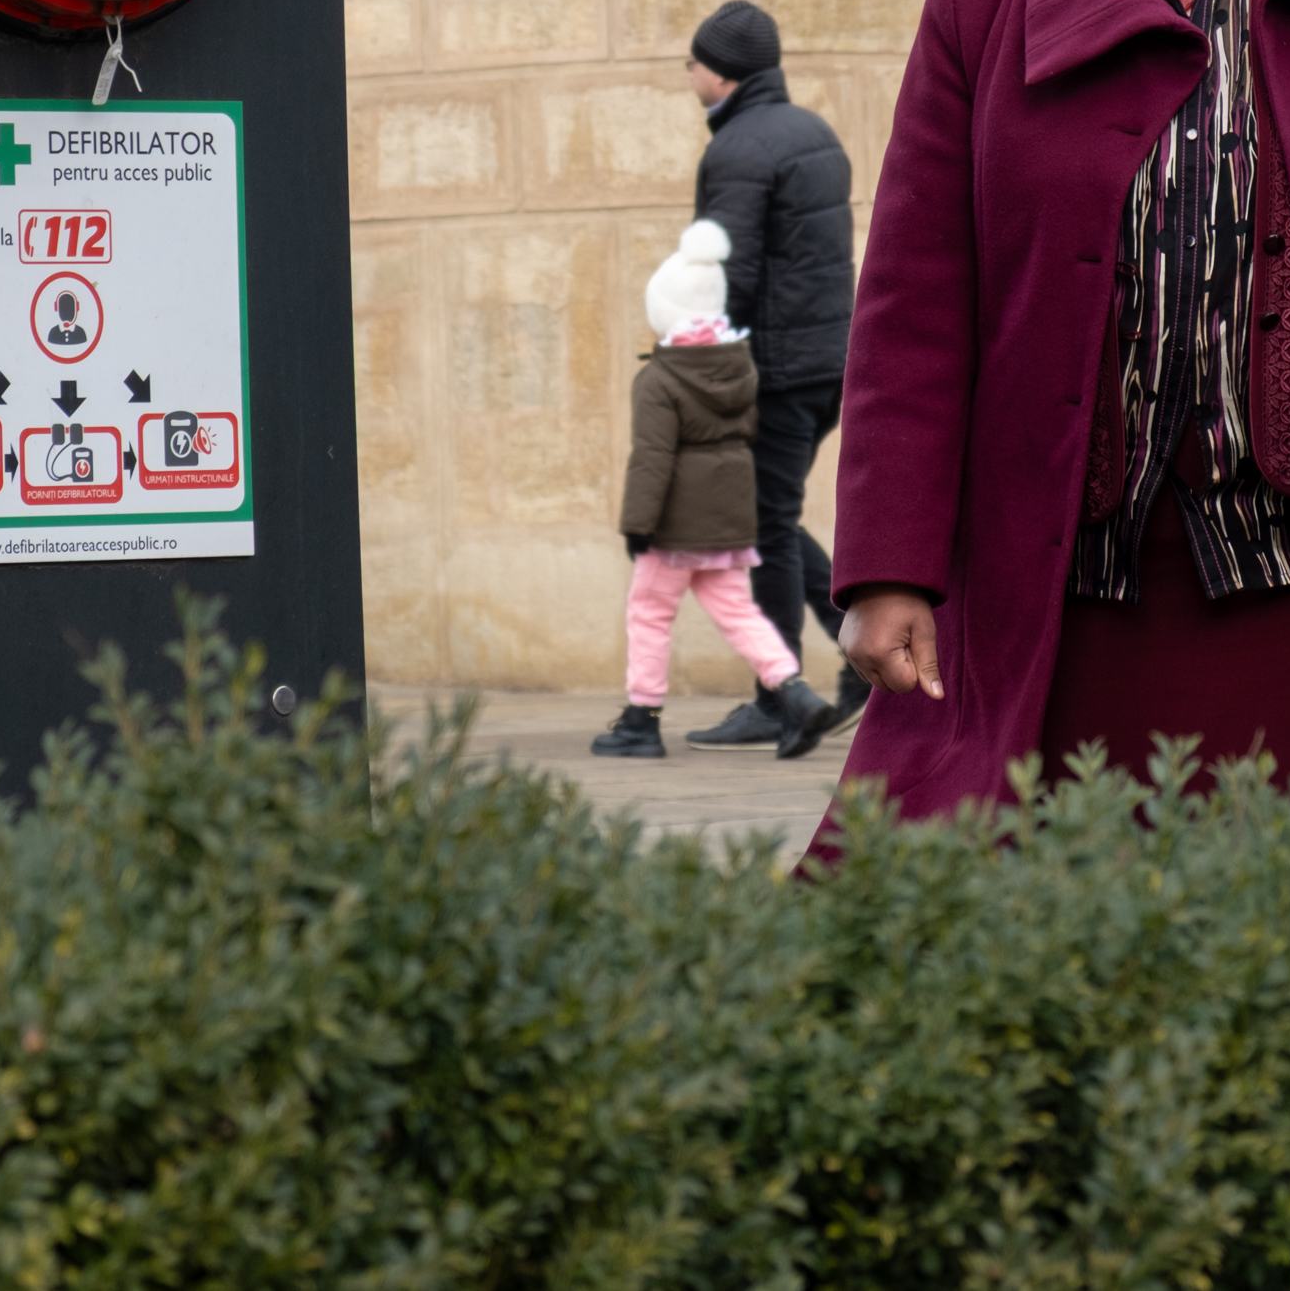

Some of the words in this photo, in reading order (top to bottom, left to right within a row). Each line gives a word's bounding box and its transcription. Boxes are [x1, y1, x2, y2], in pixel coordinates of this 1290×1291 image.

[47, 130, 217, 156] DEFIBRILATOR
[53, 167, 109, 186] pentru
[114, 166, 159, 182] acces
[164, 163, 213, 186] public
[0, 227, 14, 246] la
[45, 216, 107, 257] 112
[57, 489, 117, 499] DEFIBRILATORUL
